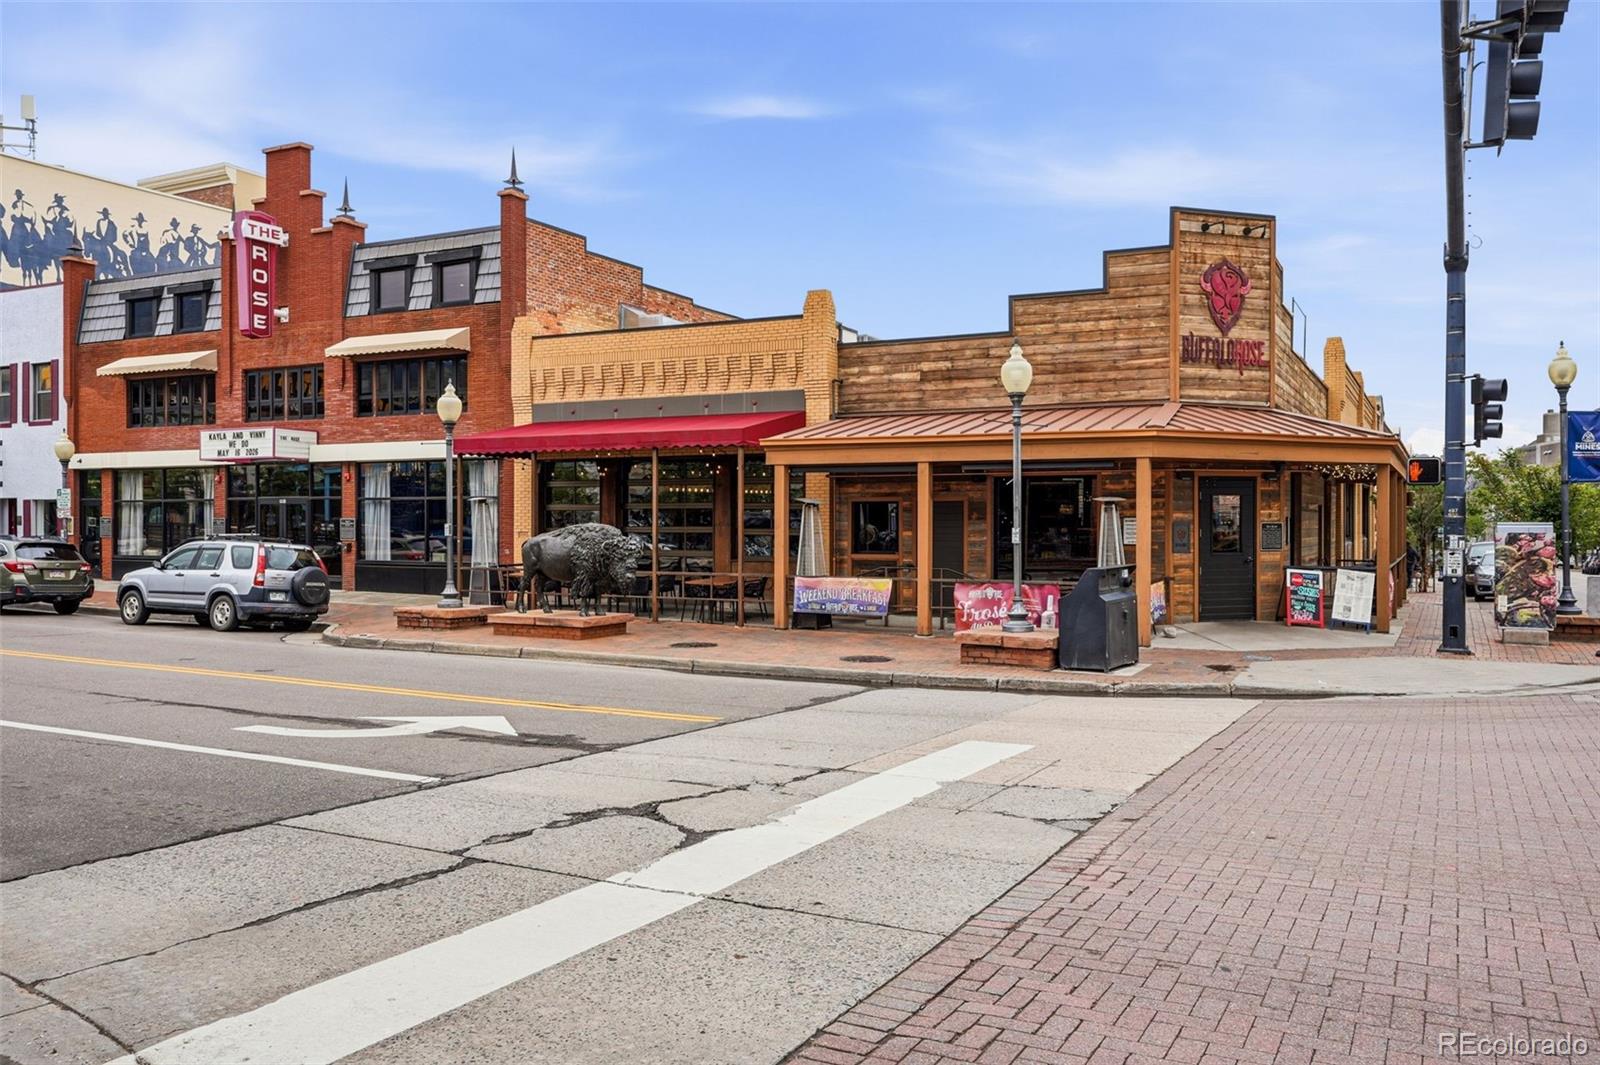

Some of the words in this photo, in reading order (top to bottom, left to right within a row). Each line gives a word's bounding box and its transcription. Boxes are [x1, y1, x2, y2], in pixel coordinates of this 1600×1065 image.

[247, 222, 281, 240] THE
[252, 245, 269, 330] ROSE
[1234, 338, 1265, 376] ROSE
[208, 432, 227, 441] KAYLA
[232, 431, 244, 440] AND
[249, 430, 266, 439] VINNY
[228, 440, 237, 448] WE
[241, 440, 249, 448] DO
[216, 449, 229, 457] MAY
[799, 588, 838, 603] WEEKEND
[840, 588, 887, 606] BREAKFAST
